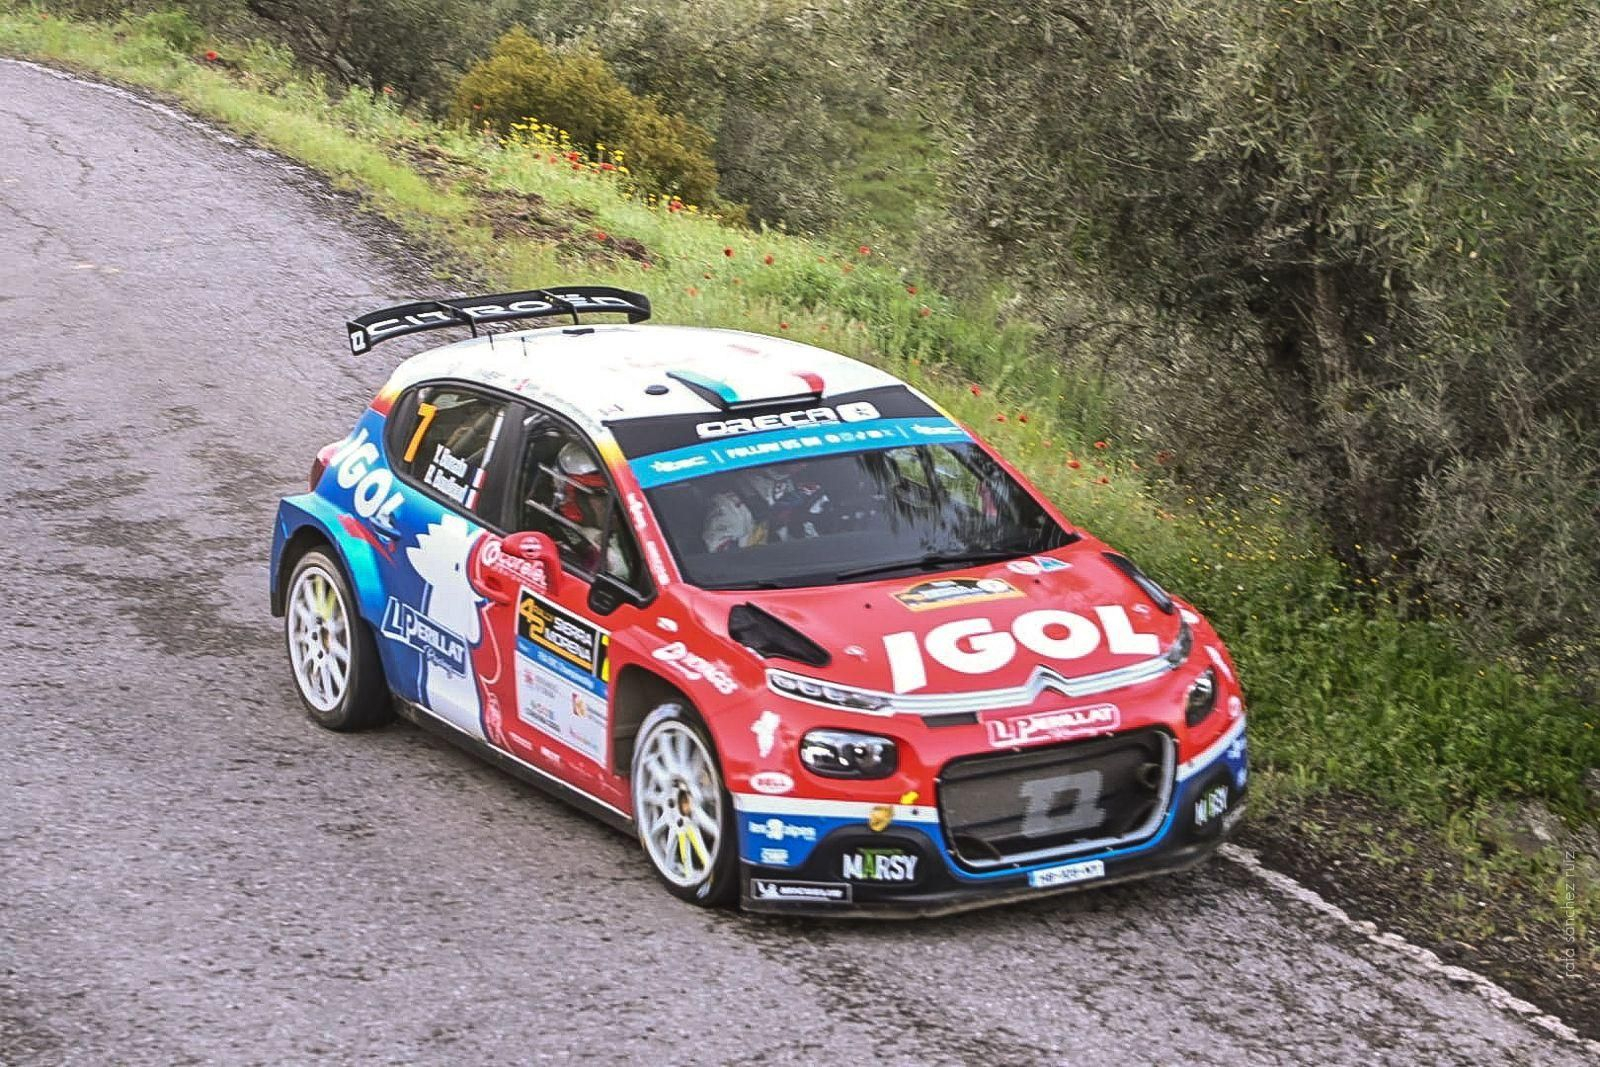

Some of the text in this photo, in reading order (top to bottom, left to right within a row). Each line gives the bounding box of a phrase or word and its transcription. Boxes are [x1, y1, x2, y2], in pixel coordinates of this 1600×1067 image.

[696, 407, 836, 438] ORECA
[330, 428, 404, 530] IGOL
[882, 605, 1160, 694] IGOL
[843, 850, 918, 881] MARSY
